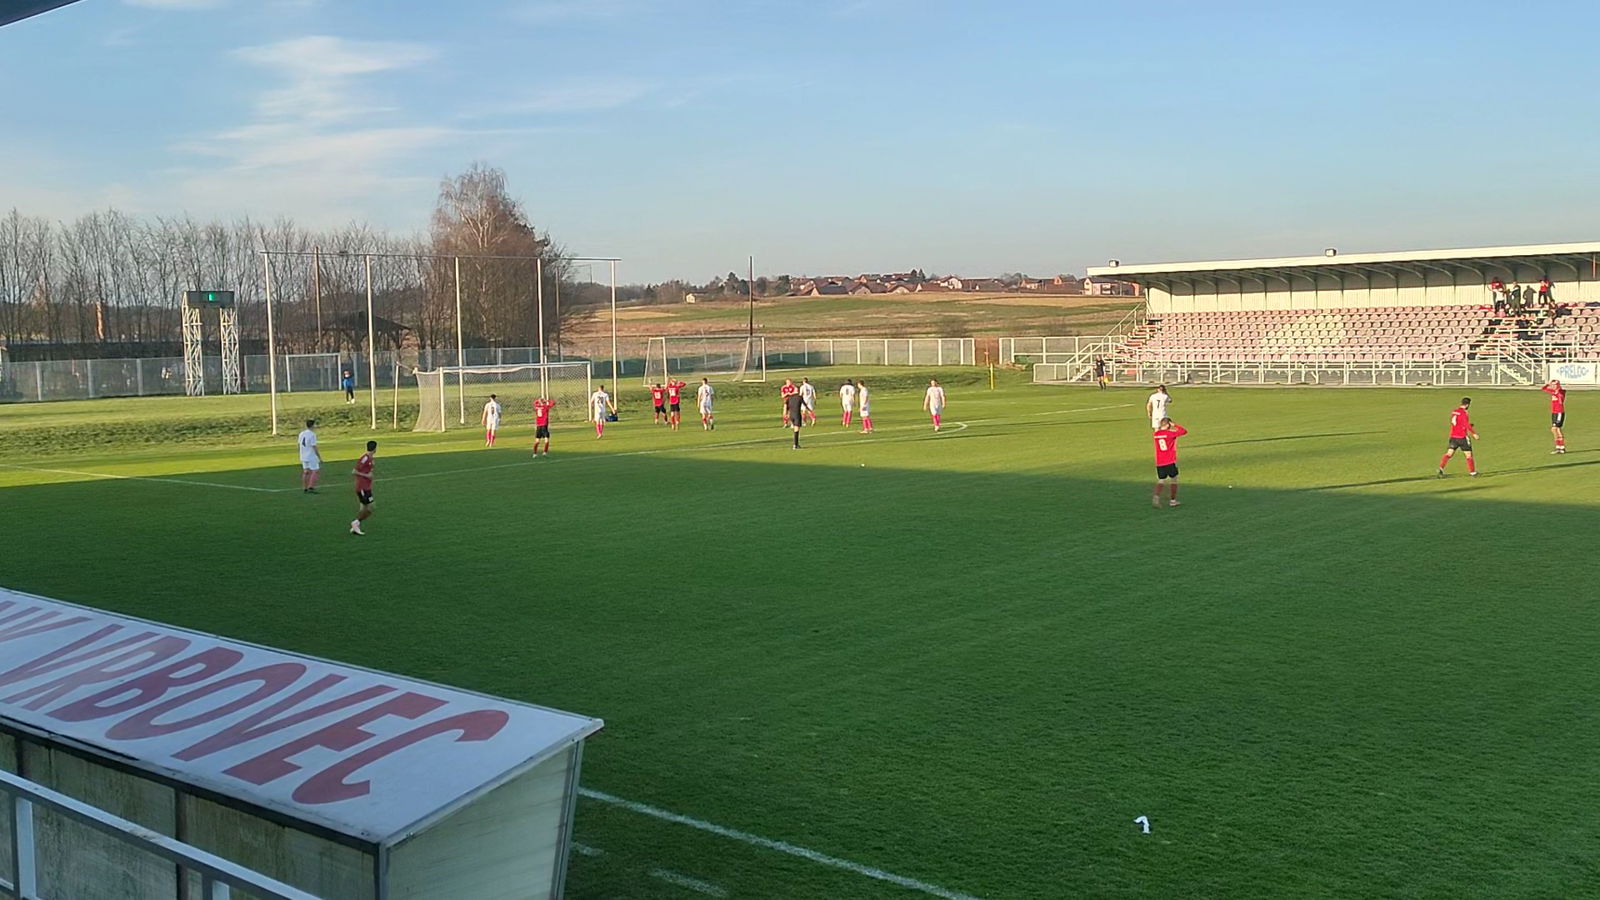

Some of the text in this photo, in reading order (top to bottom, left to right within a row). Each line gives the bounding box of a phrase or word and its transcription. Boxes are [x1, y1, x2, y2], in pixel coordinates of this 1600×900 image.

[1156, 399, 1161, 409] 7
[302, 436, 307, 447] 4
[1158, 439, 1168, 451] 8
[0, 623, 509, 805] VRBOVEC
